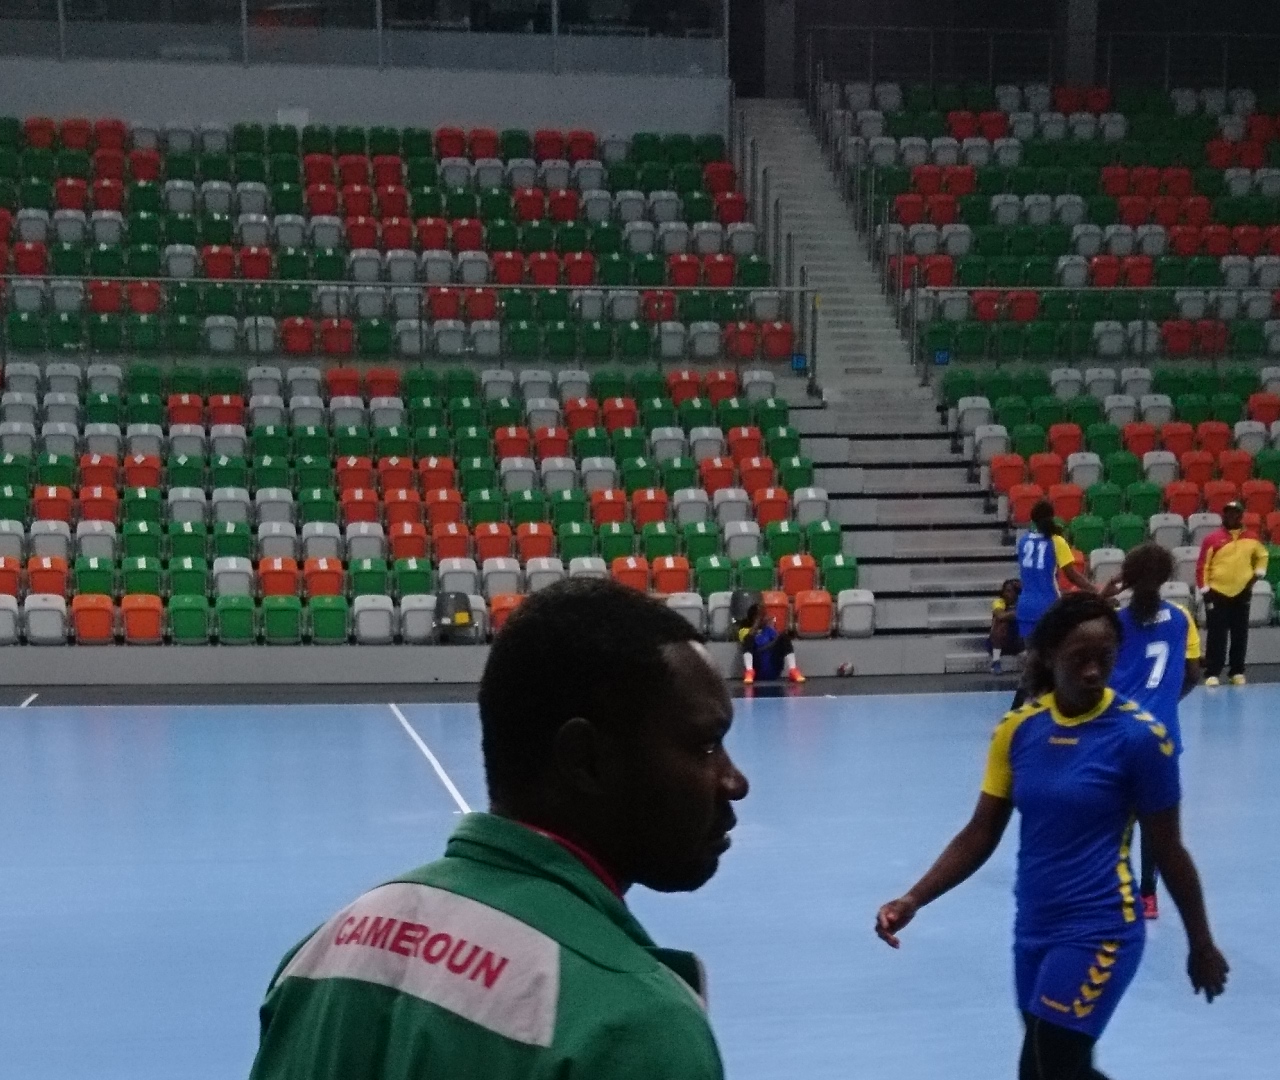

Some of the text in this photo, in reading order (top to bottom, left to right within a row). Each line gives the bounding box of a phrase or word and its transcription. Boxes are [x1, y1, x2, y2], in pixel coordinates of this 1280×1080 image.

[1022, 540, 1047, 569] 21
[1145, 641, 1169, 689] 7
[335, 915, 509, 989] CAMEROUN
